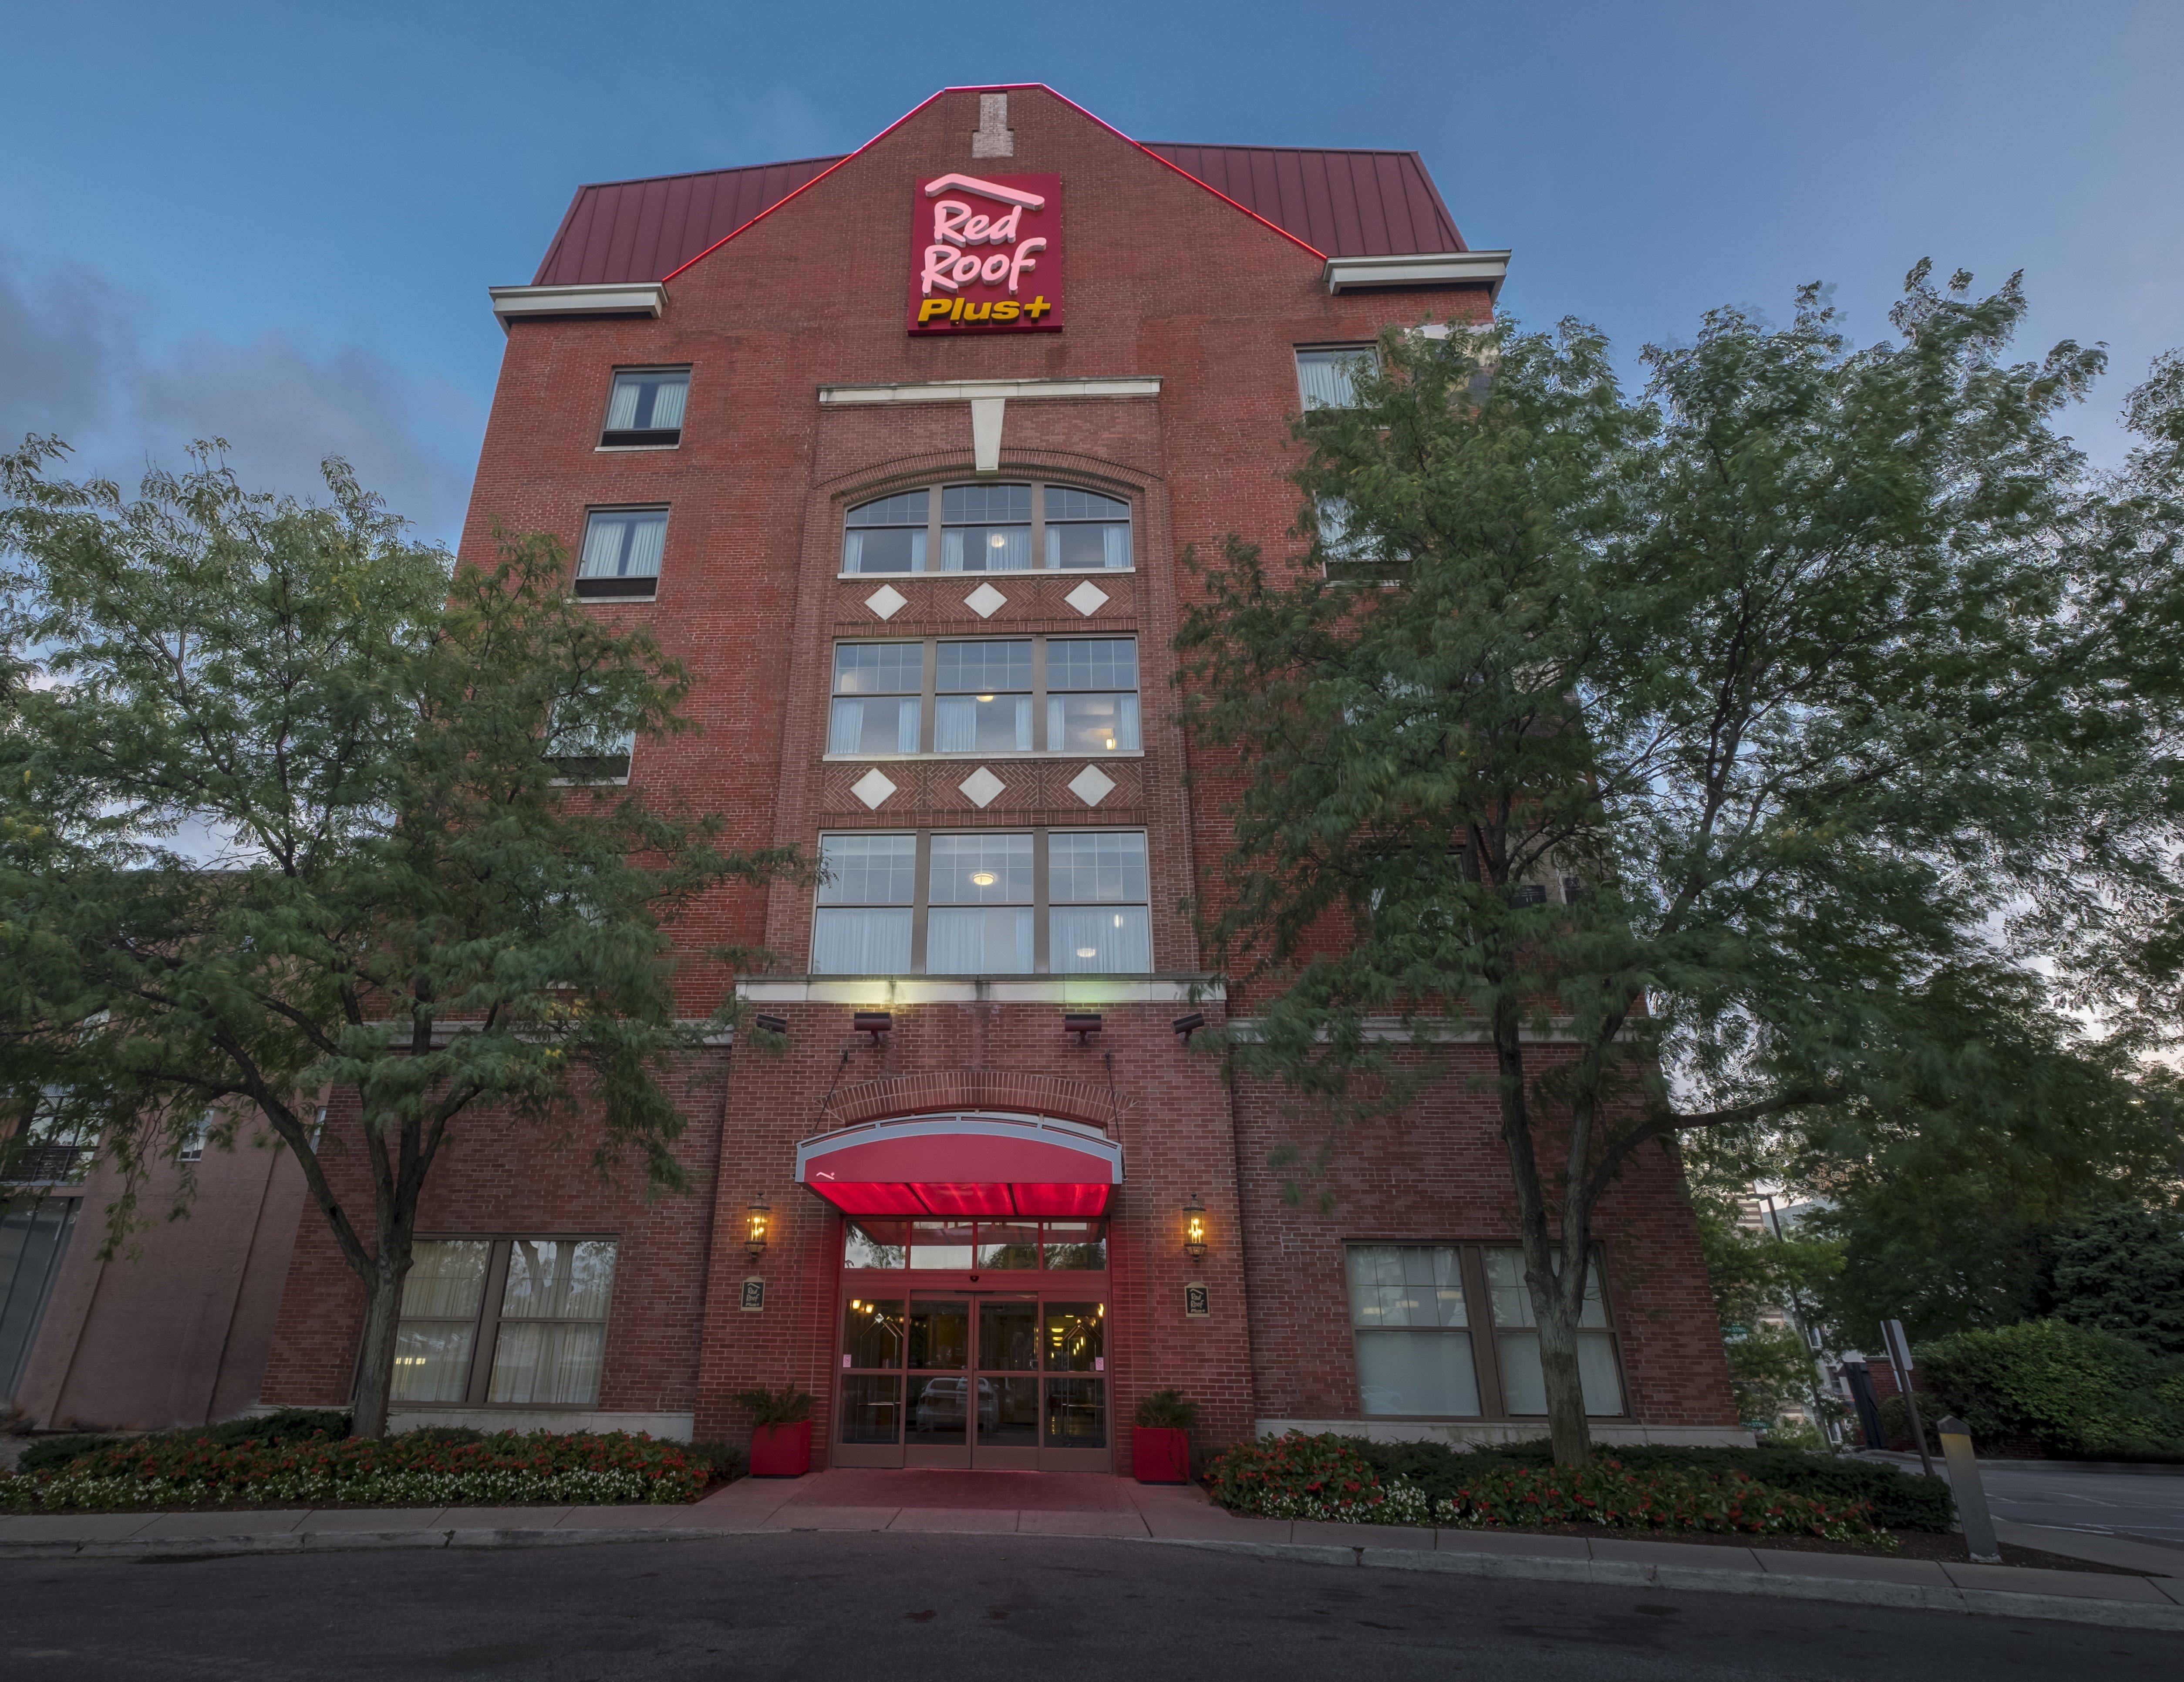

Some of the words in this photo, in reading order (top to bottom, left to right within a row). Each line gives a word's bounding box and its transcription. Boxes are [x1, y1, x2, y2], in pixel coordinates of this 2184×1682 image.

[934, 200, 1022, 247] Red
[920, 237, 1047, 298] Roof
[917, 295, 1051, 327] Plus+
[746, 1294, 760, 1302] Roof
[1190, 1300, 1204, 1308] Roof
